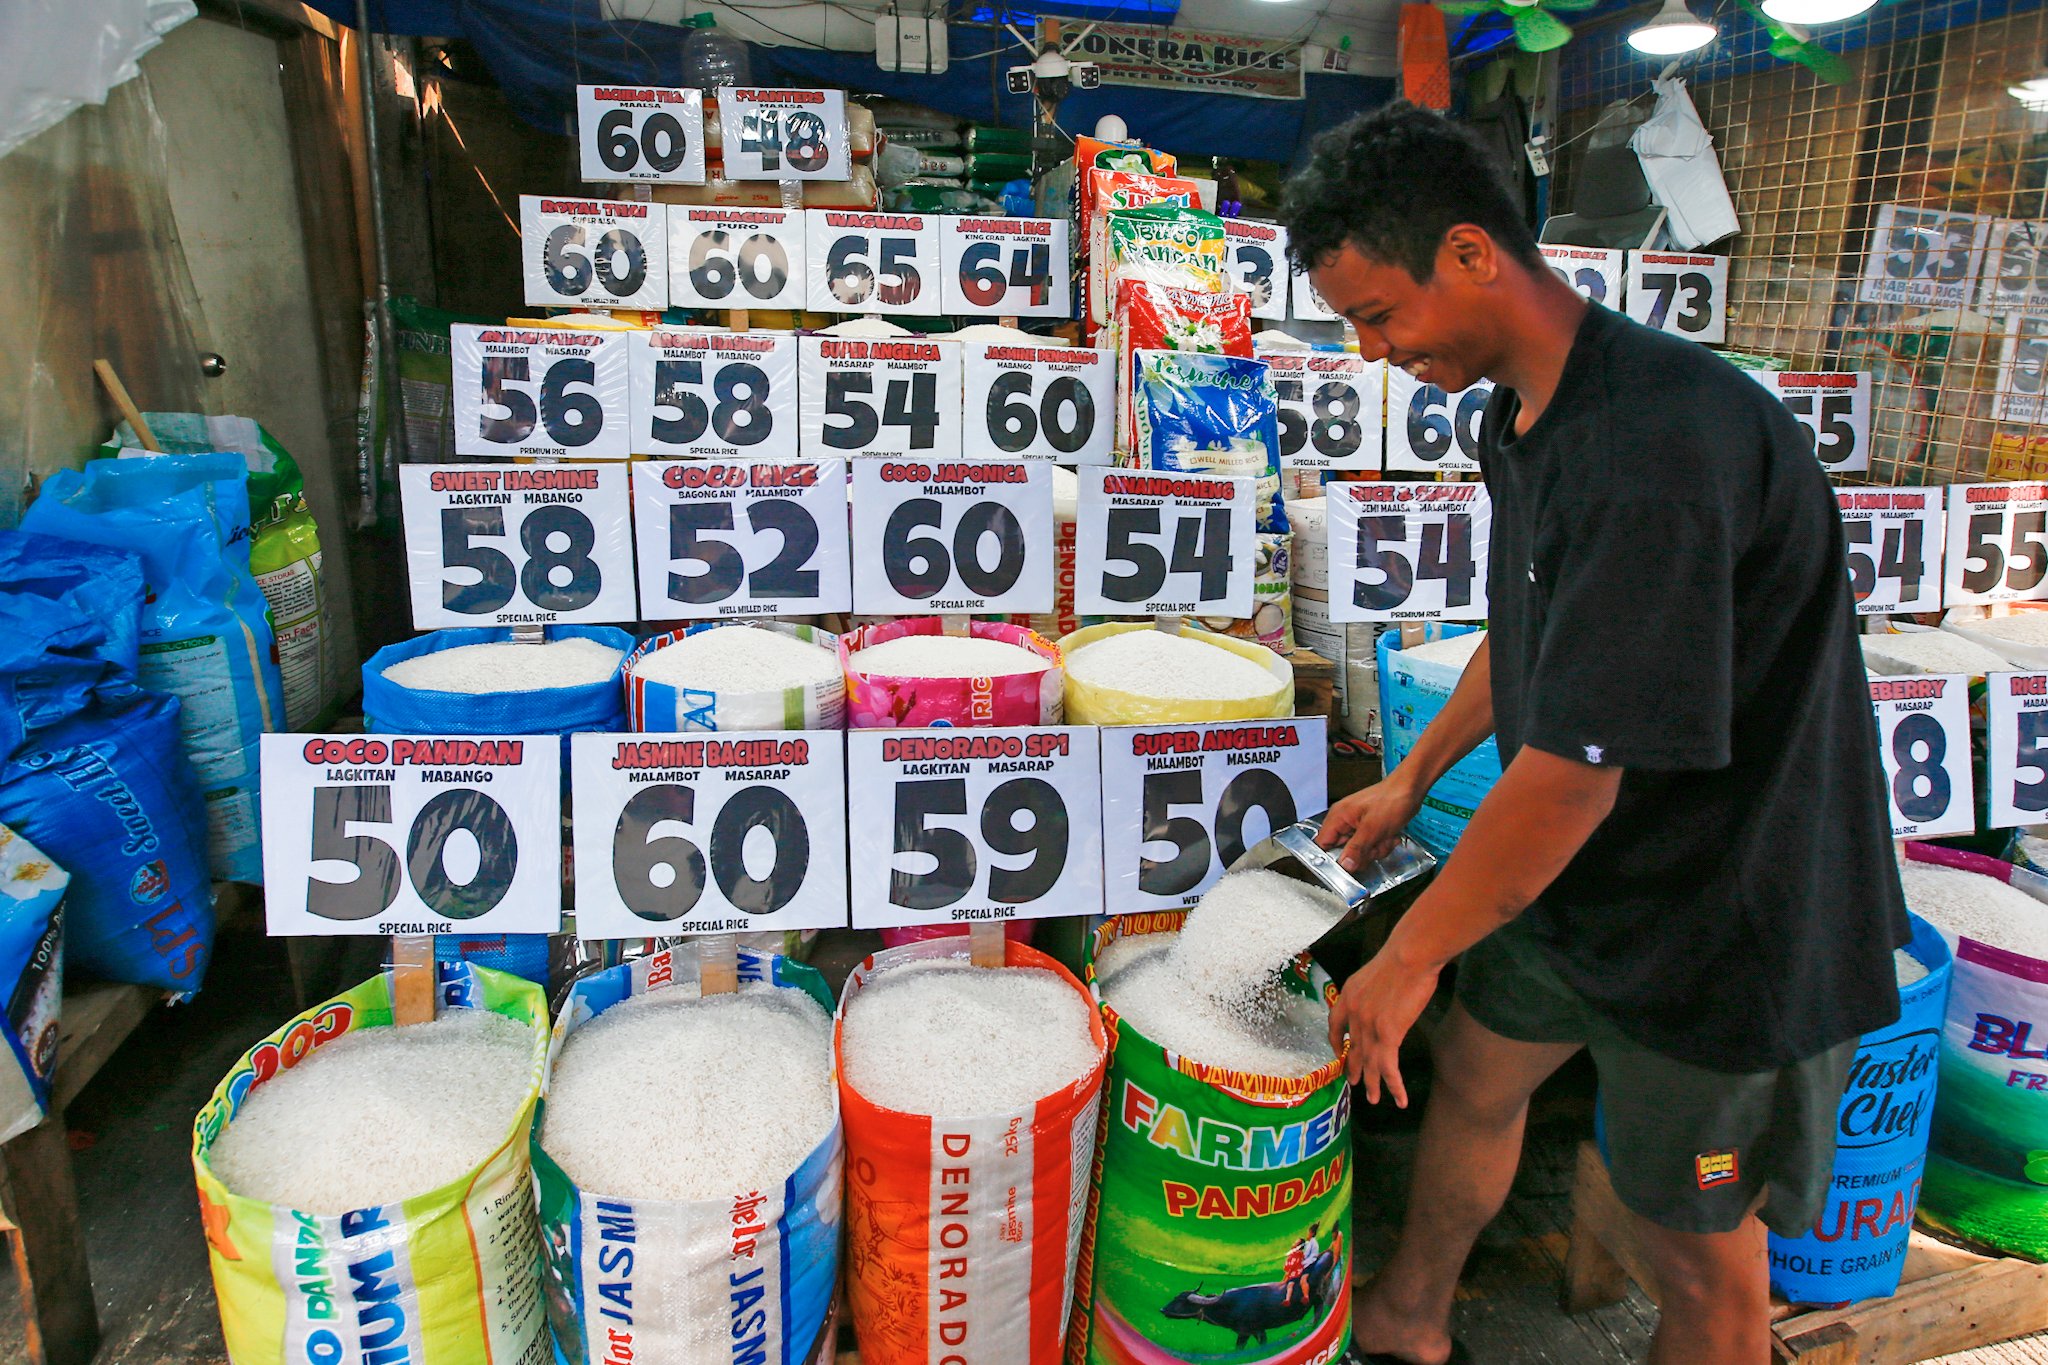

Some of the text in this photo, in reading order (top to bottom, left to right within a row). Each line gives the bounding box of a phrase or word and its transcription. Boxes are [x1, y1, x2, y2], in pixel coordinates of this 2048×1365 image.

[1061, 32, 1205, 64] SOMERA
[1214, 46, 1286, 70] RICE
[594, 88, 655, 103] BACHELOR
[736, 89, 826, 104] PLANTERS
[597, 109, 686, 172] 60
[741, 111, 830, 172] 48
[541, 200, 647, 218] ROYAL THAI
[716, 222, 760, 231] PURO
[826, 213, 924, 231] WAGWAG
[956, 218, 1052, 236] JAPANESE RICE
[964, 234, 984, 242] KING
[1140, 224, 1200, 249] BUCO
[543, 224, 648, 297] 60
[688, 230, 789, 300] 60
[825, 235, 921, 305] 65
[958, 242, 1053, 307] 64
[1872, 279, 1965, 300] ISABELA RICE
[1642, 272, 1713, 333] 73
[485, 345, 591, 357] MALAMBOT MASARAP
[649, 332, 710, 350] AROMA
[820, 340, 941, 362] SUPER ANGELICA
[663, 350, 762, 362] MALAMBOT MABANGO
[829, 360, 929, 371] MASARAP MALAMBOT
[984, 345, 1099, 365] JASMINE DENORADO
[996, 362, 1082, 373] MABANGO MALAMBOT
[1151, 354, 1253, 390] Jasmine
[1778, 372, 1858, 389] SINANDOMENG
[479, 356, 604, 447] 56
[651, 360, 773, 446] 58
[821, 371, 940, 450] 54
[986, 371, 1095, 453] 60
[1277, 381, 1362, 458] 58
[1407, 385, 1492, 462] 60
[1782, 396, 1855, 464] 55
[519, 446, 567, 456] PREMIUM RICE
[689, 446, 738, 455] SPECIAL RICE
[1197, 455, 1217, 465] WELL
[1218, 456, 1244, 466] MILLED
[430, 469, 599, 492] SWEET HASMINE
[663, 464, 820, 489] COCO RICE
[880, 463, 1029, 484] COCO JAPONICA
[448, 492, 584, 505] LAGKITAN MABANGO
[678, 488, 804, 500] BAGONG MALAMBOT
[923, 485, 985, 497] MALAMBOT
[1103, 473, 1235, 501] SINANDOMENG
[1349, 485, 1395, 503] RICE
[441, 504, 602, 615] 58
[667, 499, 820, 604] 52
[883, 498, 1026, 600] 60
[1101, 508, 1233, 603] 54
[1962, 511, 2048, 594] 55
[1352, 513, 1476, 611] 54
[1842, 520, 1925, 604] 54
[718, 604, 778, 616] WELL MILLED RICE
[929, 599, 985, 610] SPECIAL RICE
[1145, 602, 1197, 613] SPECIAL RICE
[1390, 610, 1425, 619] PREMIUM
[293, 620, 318, 638] Facts
[496, 613, 557, 623] SPECIAL RICE
[2010, 675, 2048, 697] RICE
[1895, 701, 1934, 712] MASARAP
[304, 738, 524, 766] COCO PANDAN
[882, 734, 1071, 761] DENORADO SP1
[1132, 726, 1300, 757] SUPER ANGELICA
[612, 739, 809, 770] JASMINE BACHELOR
[1146, 750, 1282, 771] MALAMBOT MASARAP
[2012, 710, 2048, 812] 5
[326, 768, 494, 784] LAGKITAN MABANGO
[628, 768, 791, 783] MALAMBOT MASARAP
[903, 760, 1055, 776] LAGKITAN MASARAP
[1138, 768, 1298, 897] 50
[1903, 825, 1918, 834] RICE
[306, 784, 519, 921] 50
[612, 783, 810, 922] 60
[888, 777, 1070, 910] 59
[681, 917, 749, 932] SPECIAL RICE
[951, 905, 1016, 921] SPECIAL RICE
[378, 921, 453, 935] SPECIAL RICE
[1967, 1012, 2048, 1059] BL
[1840, 1083, 1933, 1138] Chef
[1005, 1116, 1023, 1157] 25kg
[1121, 1078, 1350, 1172] FARMER
[1161, 1150, 1345, 1220] PANDAN
[1831, 1166, 1902, 1191] REMIUM
[494, 1187, 520, 1207] Rinse
[497, 1199, 520, 1222] water
[1006, 1186, 1017, 1244] Jasmine
[596, 1201, 637, 1326] JASMI
[1840, 1250, 1893, 1275] GRAIN
